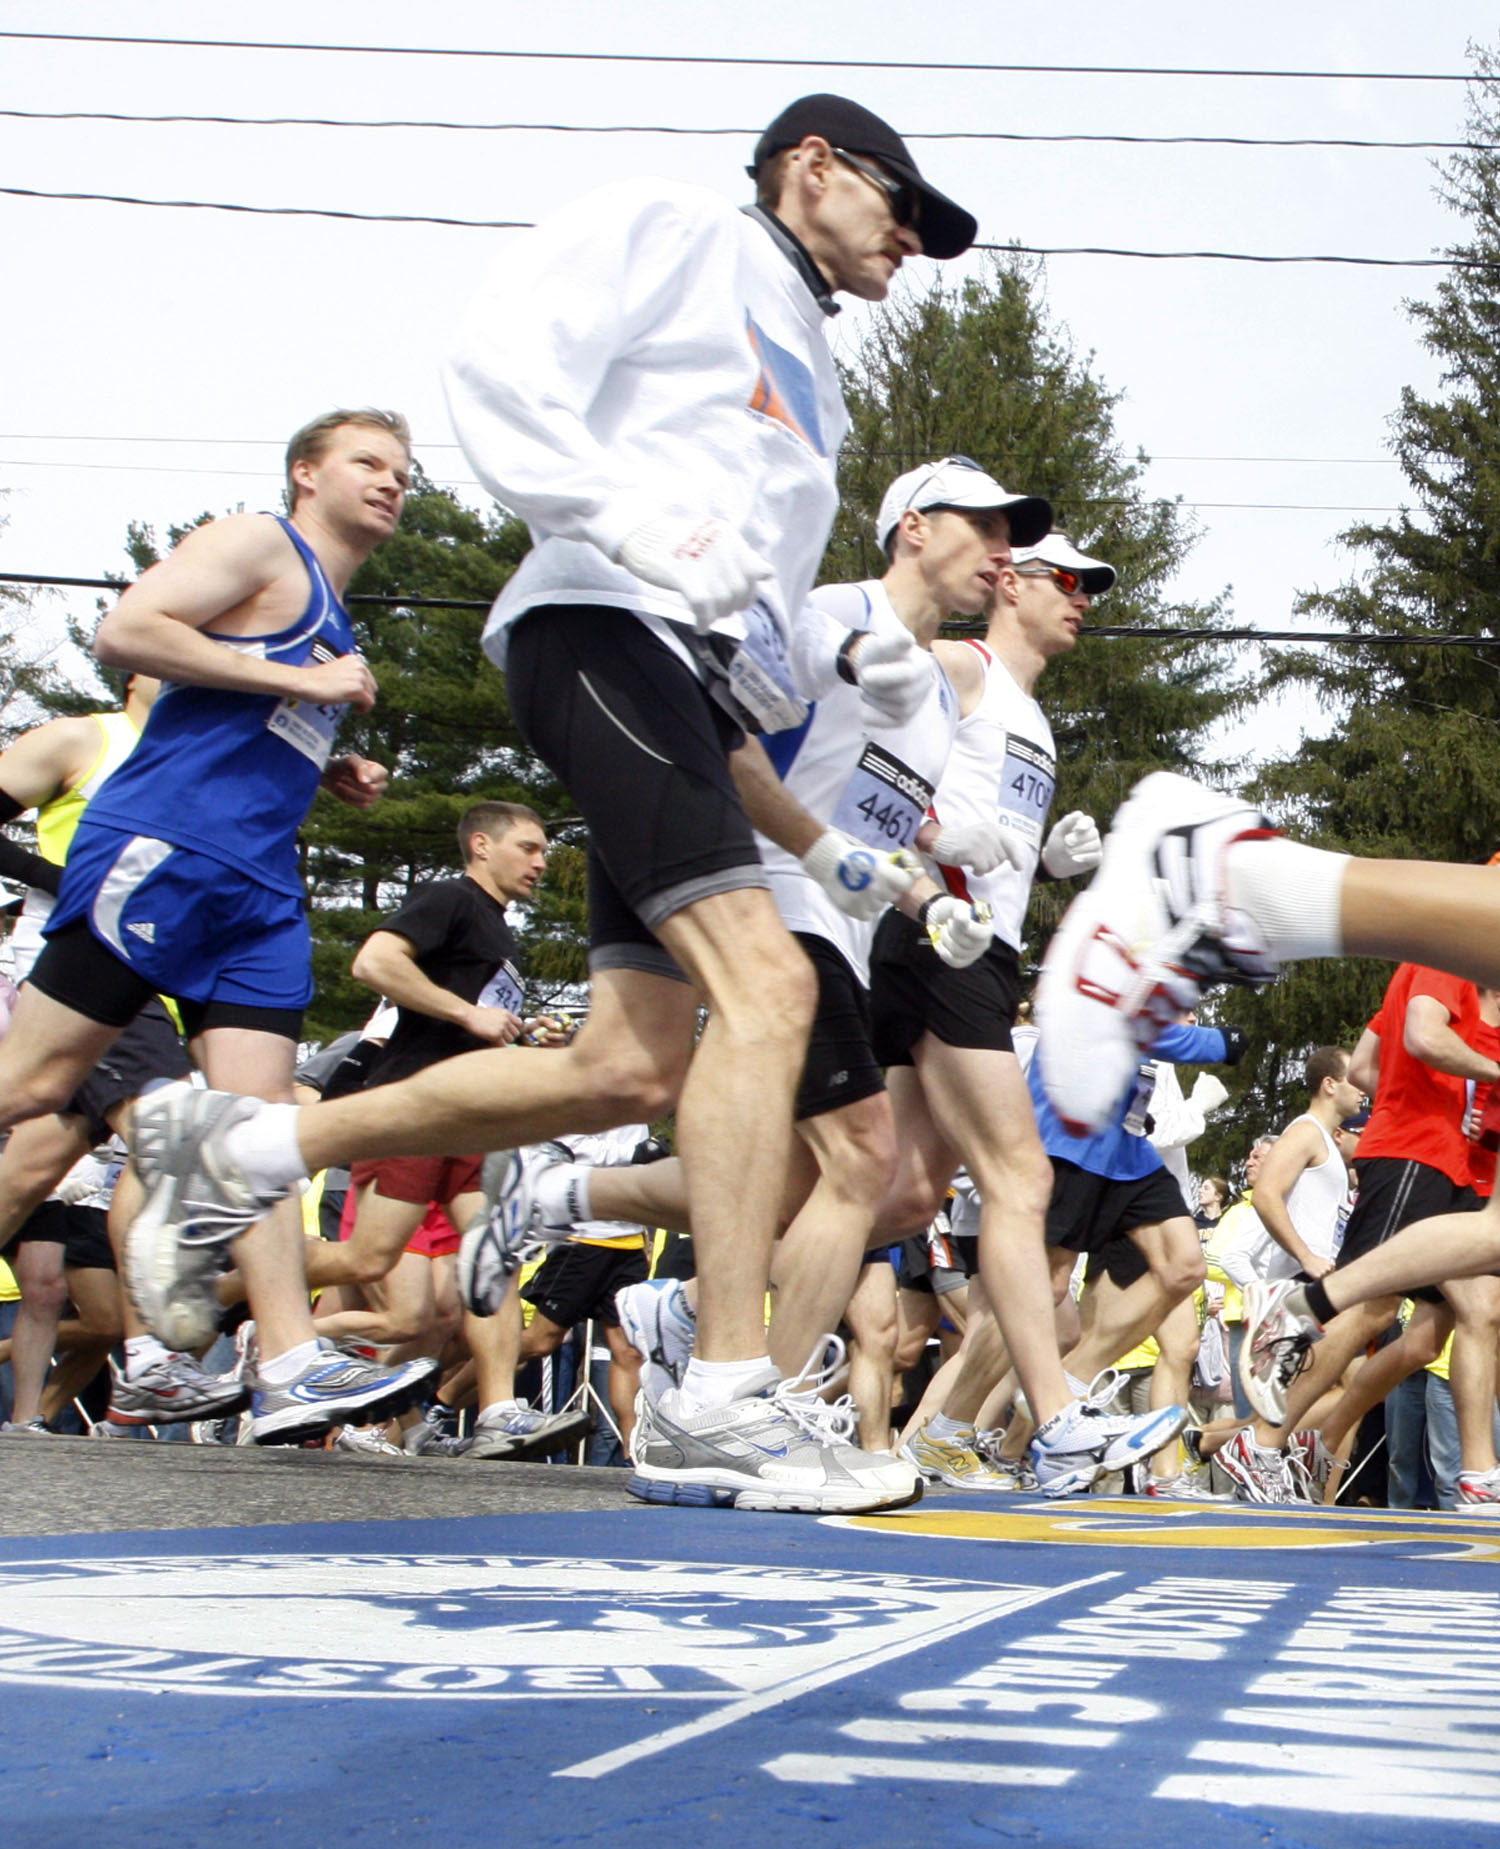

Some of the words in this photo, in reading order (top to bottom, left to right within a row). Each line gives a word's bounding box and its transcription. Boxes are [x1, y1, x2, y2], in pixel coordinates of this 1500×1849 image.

[1011, 773, 1051, 808] 470
[82, 1557, 958, 1589] ASSOCIATION
[1007, 1576, 1295, 1661] BOSTON
